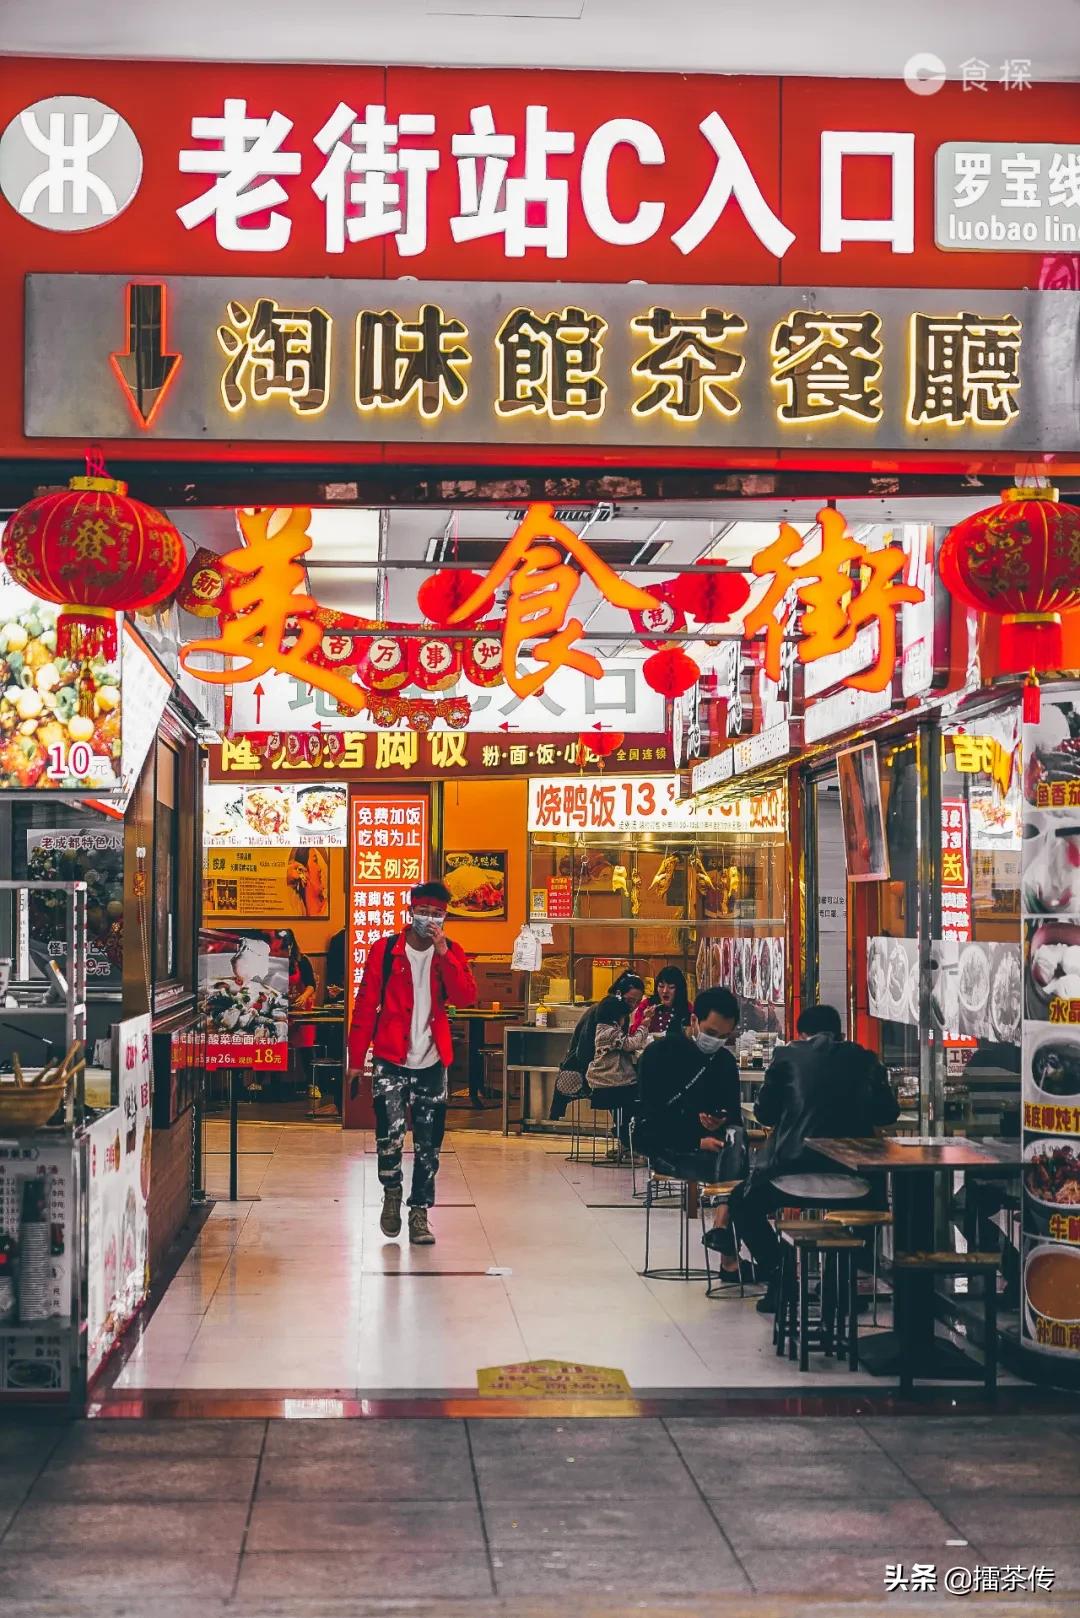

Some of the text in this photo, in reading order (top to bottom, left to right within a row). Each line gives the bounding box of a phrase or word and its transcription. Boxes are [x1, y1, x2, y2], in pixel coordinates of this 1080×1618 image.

[176, 98, 916, 258] 老街站C入口
[952, 151, 1080, 208] 罗宝线
[949, 213, 1080, 242] luobao lin
[216, 297, 1023, 426] 淘味館茶餐廳
[180, 503, 925, 713] 美食街
[616, 747, 667, 762] 全国连锁
[357, 806, 421, 826] 免费加饭
[357, 828, 421, 848] 吃饱为止
[357, 850, 420, 880] 送例汤
[353, 890, 396, 907] 猪脚饭
[353, 909, 396, 927] 烧鸭饭
